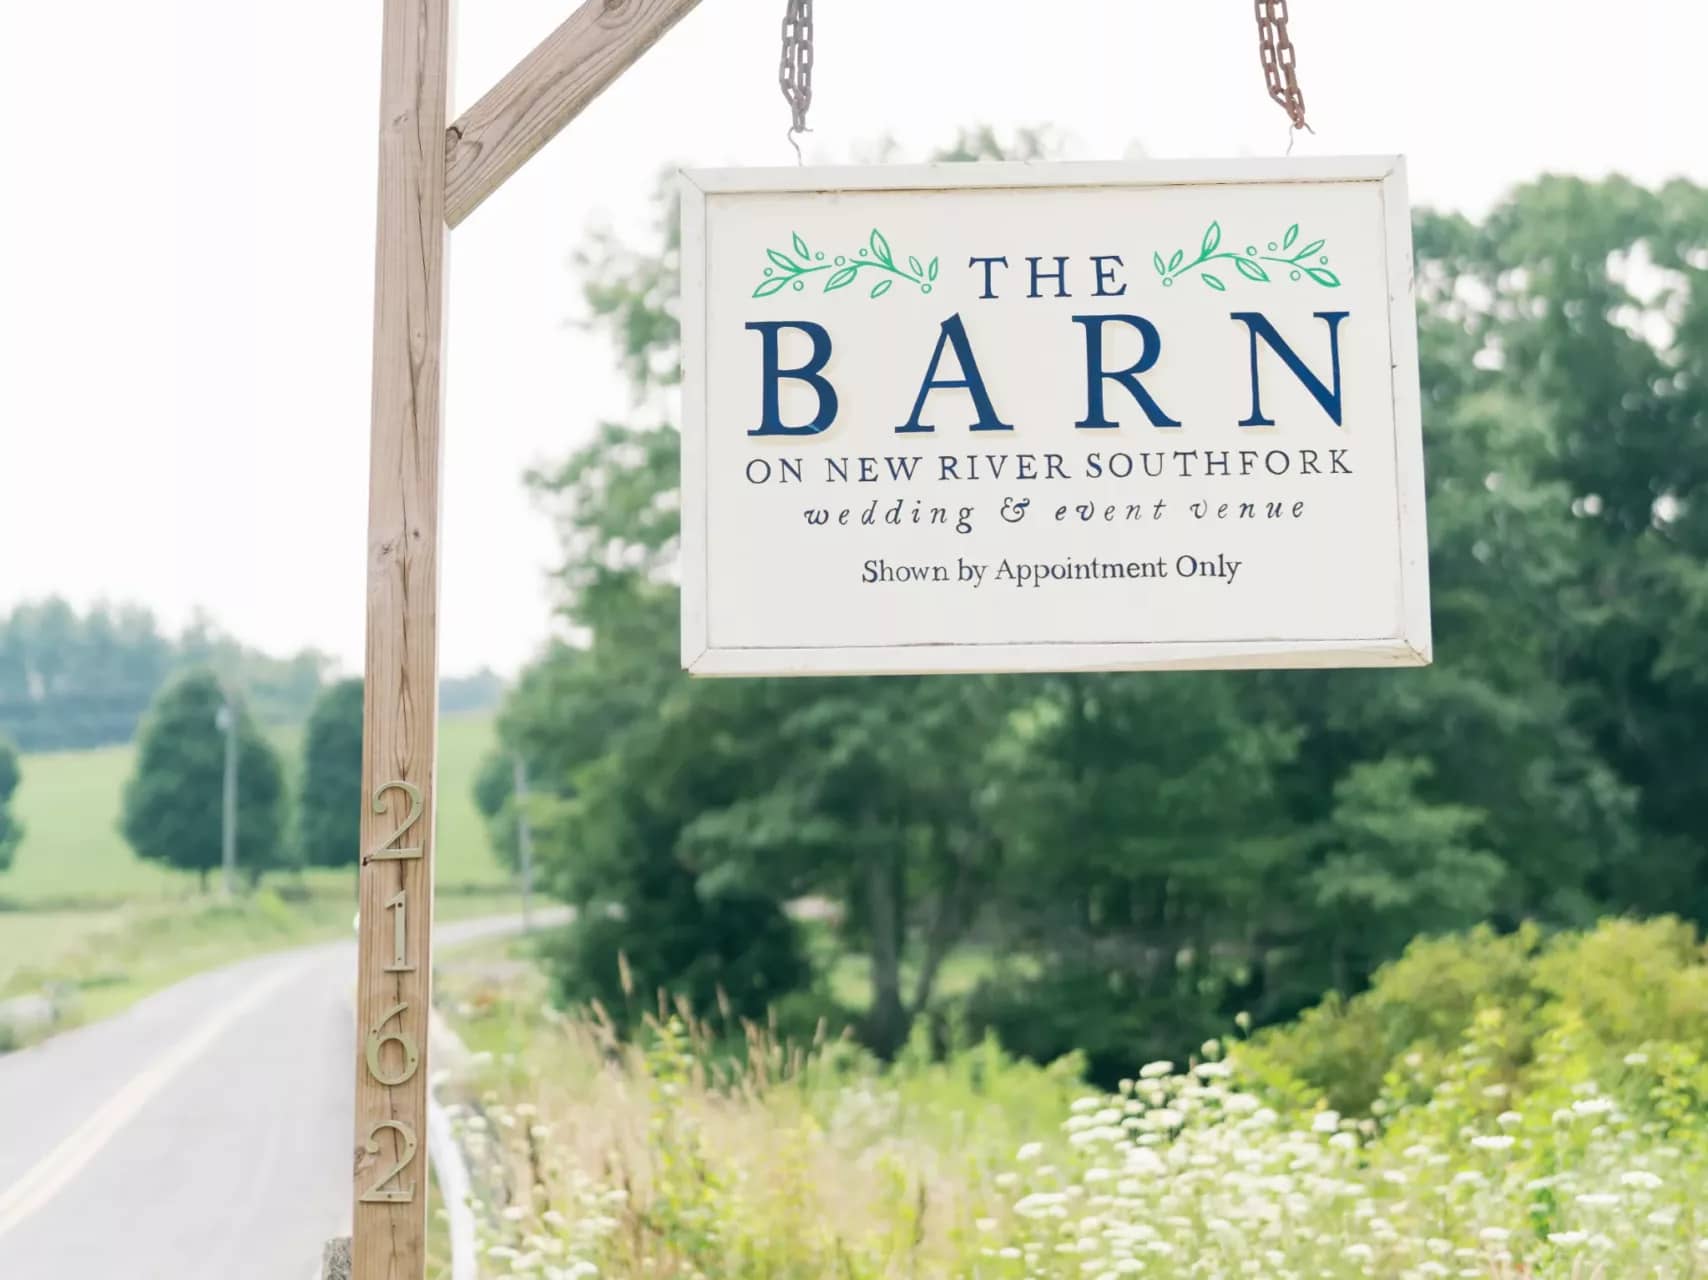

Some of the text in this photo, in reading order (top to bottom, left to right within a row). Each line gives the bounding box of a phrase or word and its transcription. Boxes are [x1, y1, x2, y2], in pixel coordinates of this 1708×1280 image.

[968, 255, 1128, 300] THE
[744, 311, 1351, 437] BARN
[745, 449, 1354, 484] ON NEW RIVER SOUTHFORK
[803, 497, 1306, 535] wedding & event venue
[861, 553, 1242, 590] Shown by Appointment Only
